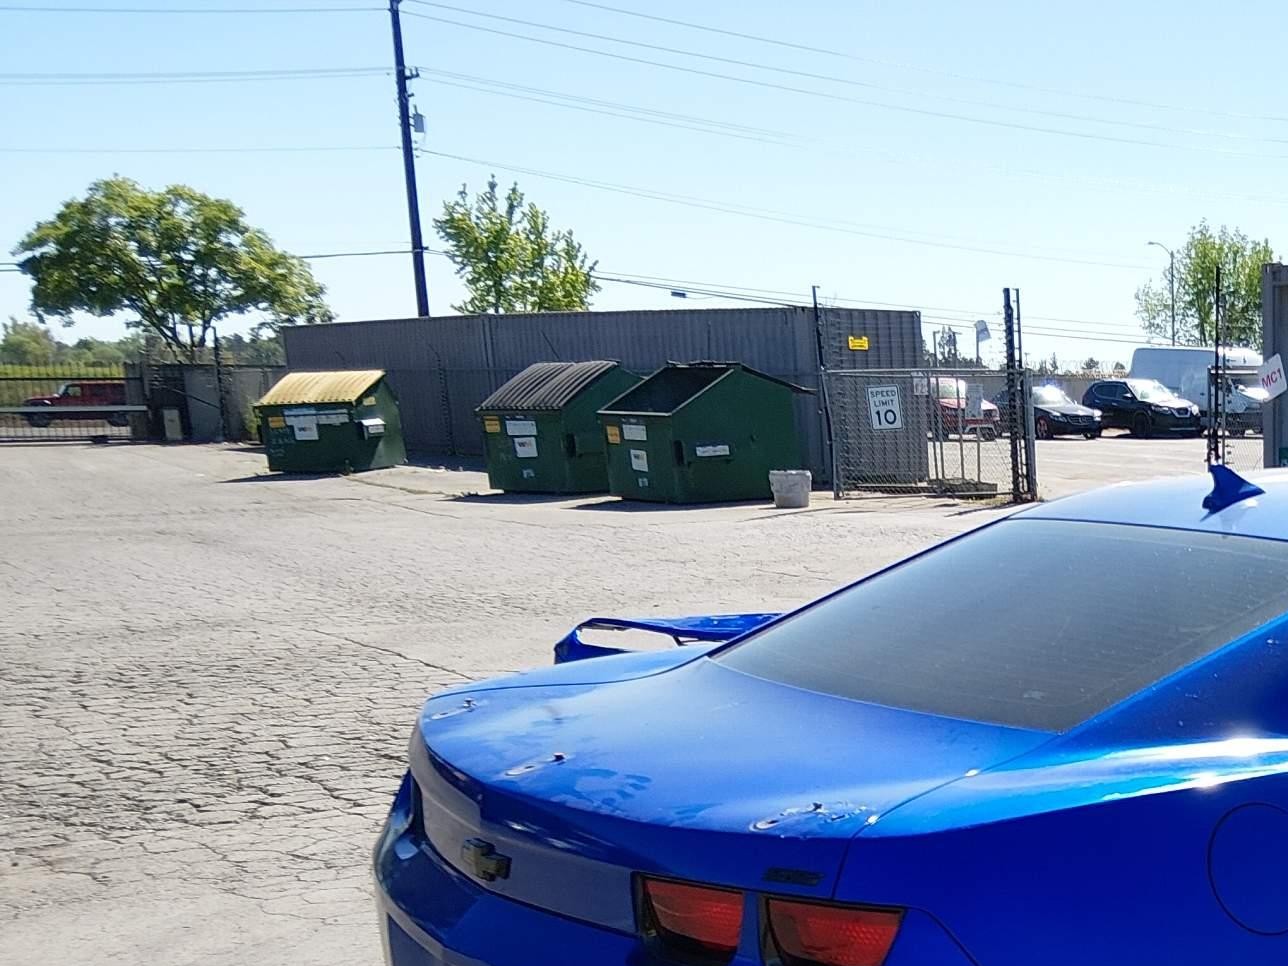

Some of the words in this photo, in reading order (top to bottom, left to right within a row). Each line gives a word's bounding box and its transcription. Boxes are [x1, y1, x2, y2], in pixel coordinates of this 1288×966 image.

[1261, 368, 1282, 388] MC1
[870, 390, 896, 398] SPEED
[873, 399, 894, 408] LIMIT
[875, 409, 897, 426] 10
